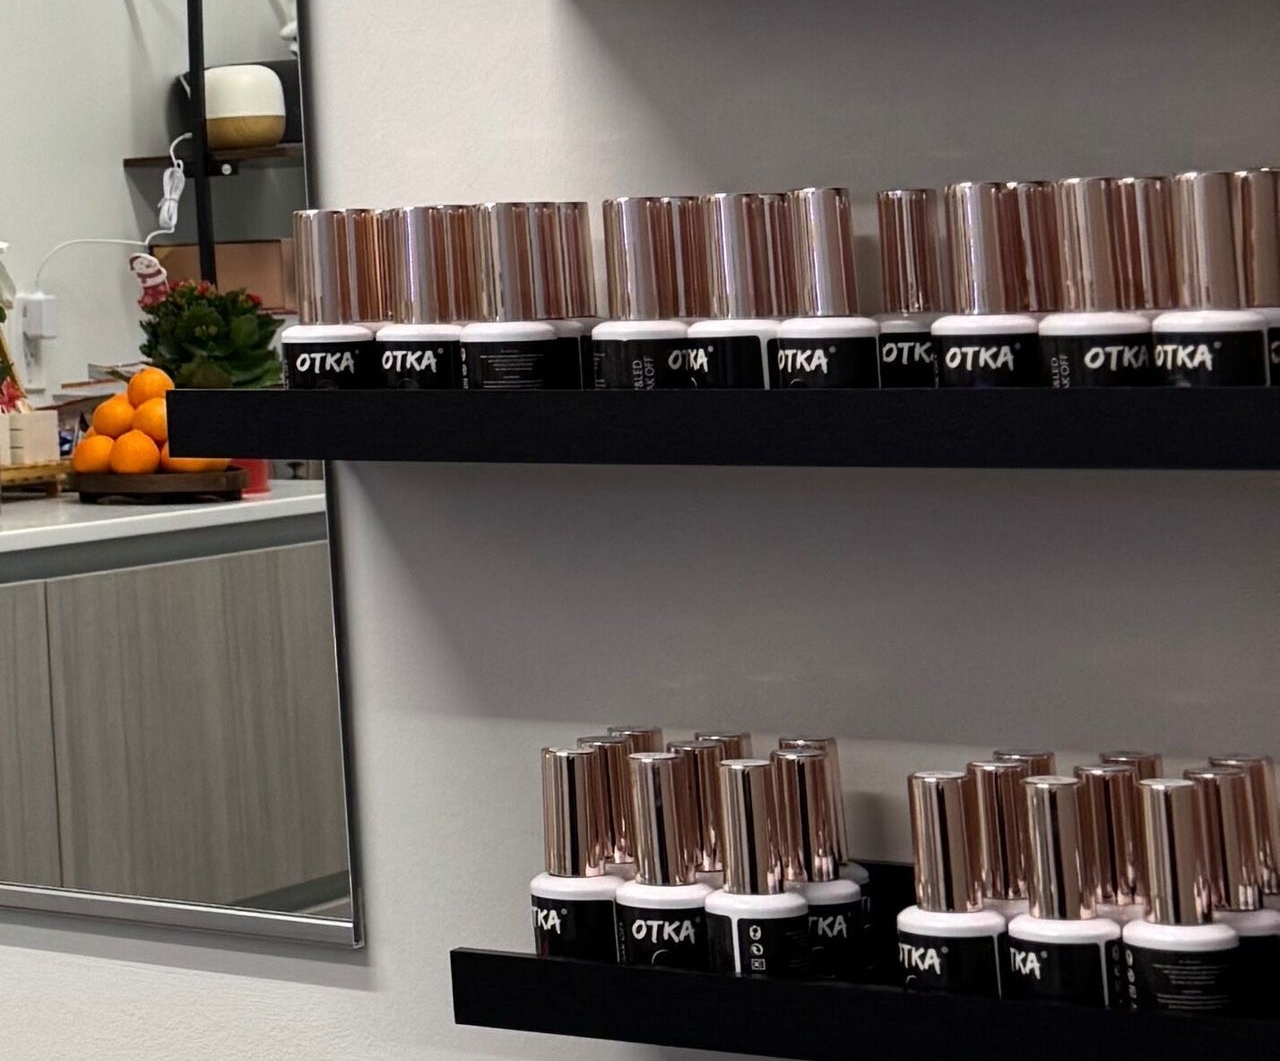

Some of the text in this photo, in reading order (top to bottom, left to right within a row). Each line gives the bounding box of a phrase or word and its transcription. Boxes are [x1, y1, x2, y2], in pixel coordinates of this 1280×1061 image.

[296, 351, 355, 374] OTKA
[381, 350, 438, 374] OTKA
[778, 348, 829, 374] OTKA
[882, 342, 934, 365] OTK
[945, 345, 1014, 371] OTKA
[1084, 344, 1150, 371] OTKA
[1154, 344, 1213, 370] OTKA
[631, 918, 695, 944] OTKA
